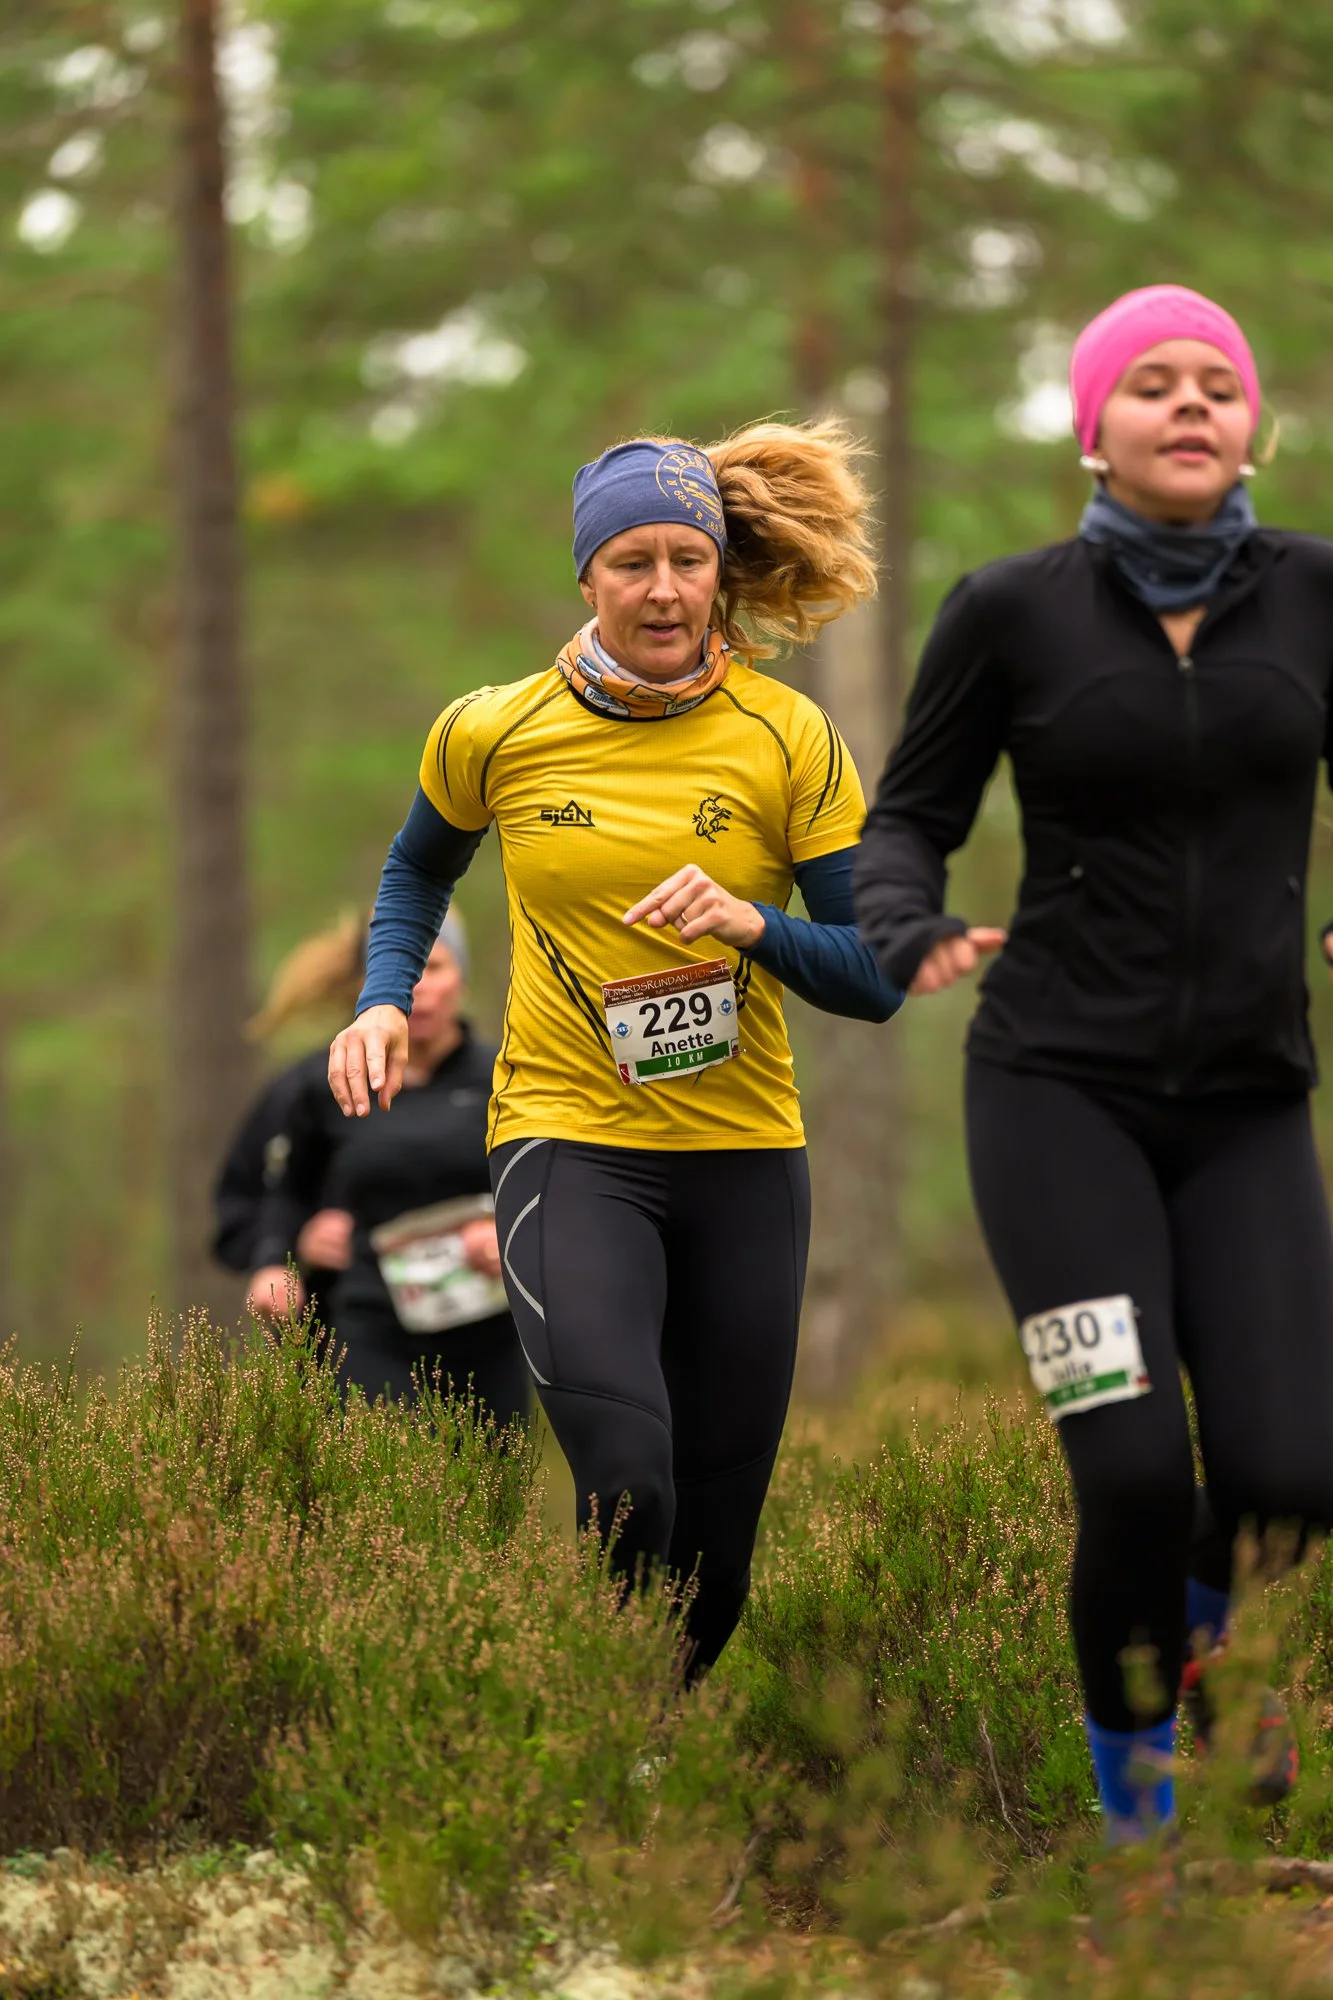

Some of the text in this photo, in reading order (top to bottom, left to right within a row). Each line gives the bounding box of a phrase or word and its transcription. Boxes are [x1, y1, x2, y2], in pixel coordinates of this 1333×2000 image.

[639, 992, 713, 1038] 229
[651, 1033, 714, 1058] Anette
[667, 1052, 704, 1068] 10 KM
